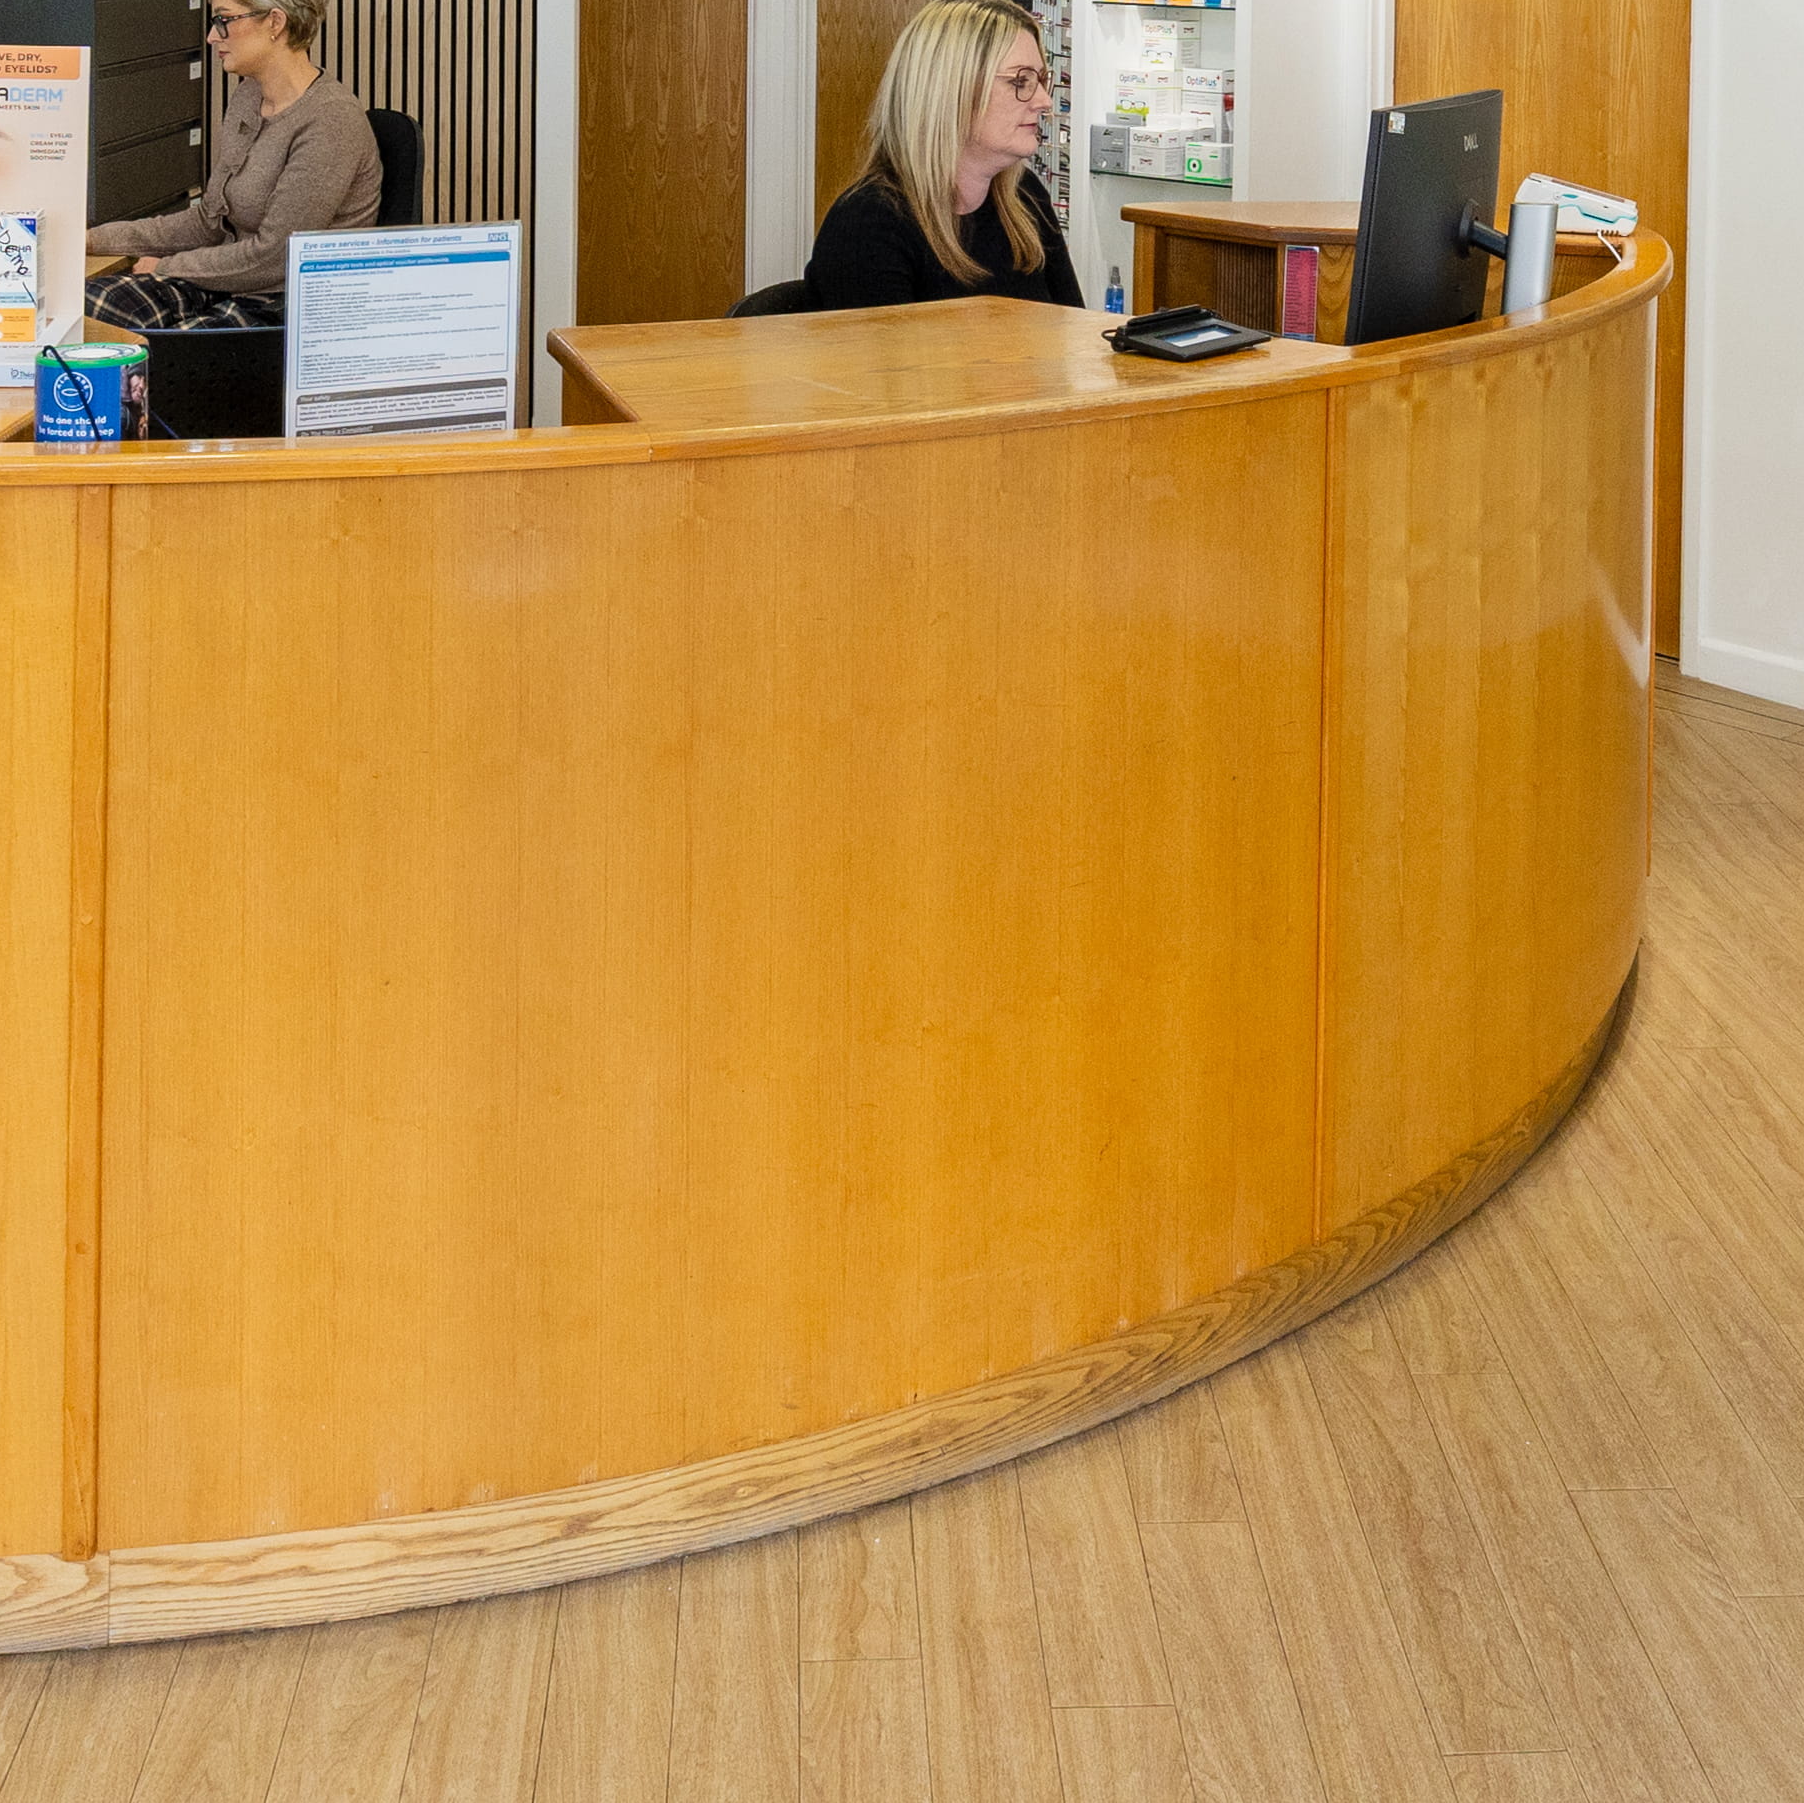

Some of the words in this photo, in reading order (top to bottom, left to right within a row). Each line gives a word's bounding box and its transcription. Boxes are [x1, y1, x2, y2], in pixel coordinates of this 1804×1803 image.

[17, 52, 43, 63] DRY,
[4, 65, 58, 74] EYELIDS?
[1119, 73, 1146, 84] OptiPlus
[1186, 75, 1217, 87] OptiPlus
[1133, 133, 1160, 144] OptiPlus
[489, 232, 509, 242] NHS
[303, 242, 318, 250] Eye
[338, 239, 370, 248] services
[42, 415, 55, 424] No
[56, 417, 72, 425] one
[75, 416, 107, 425] shold
[75, 428, 87, 437] to
